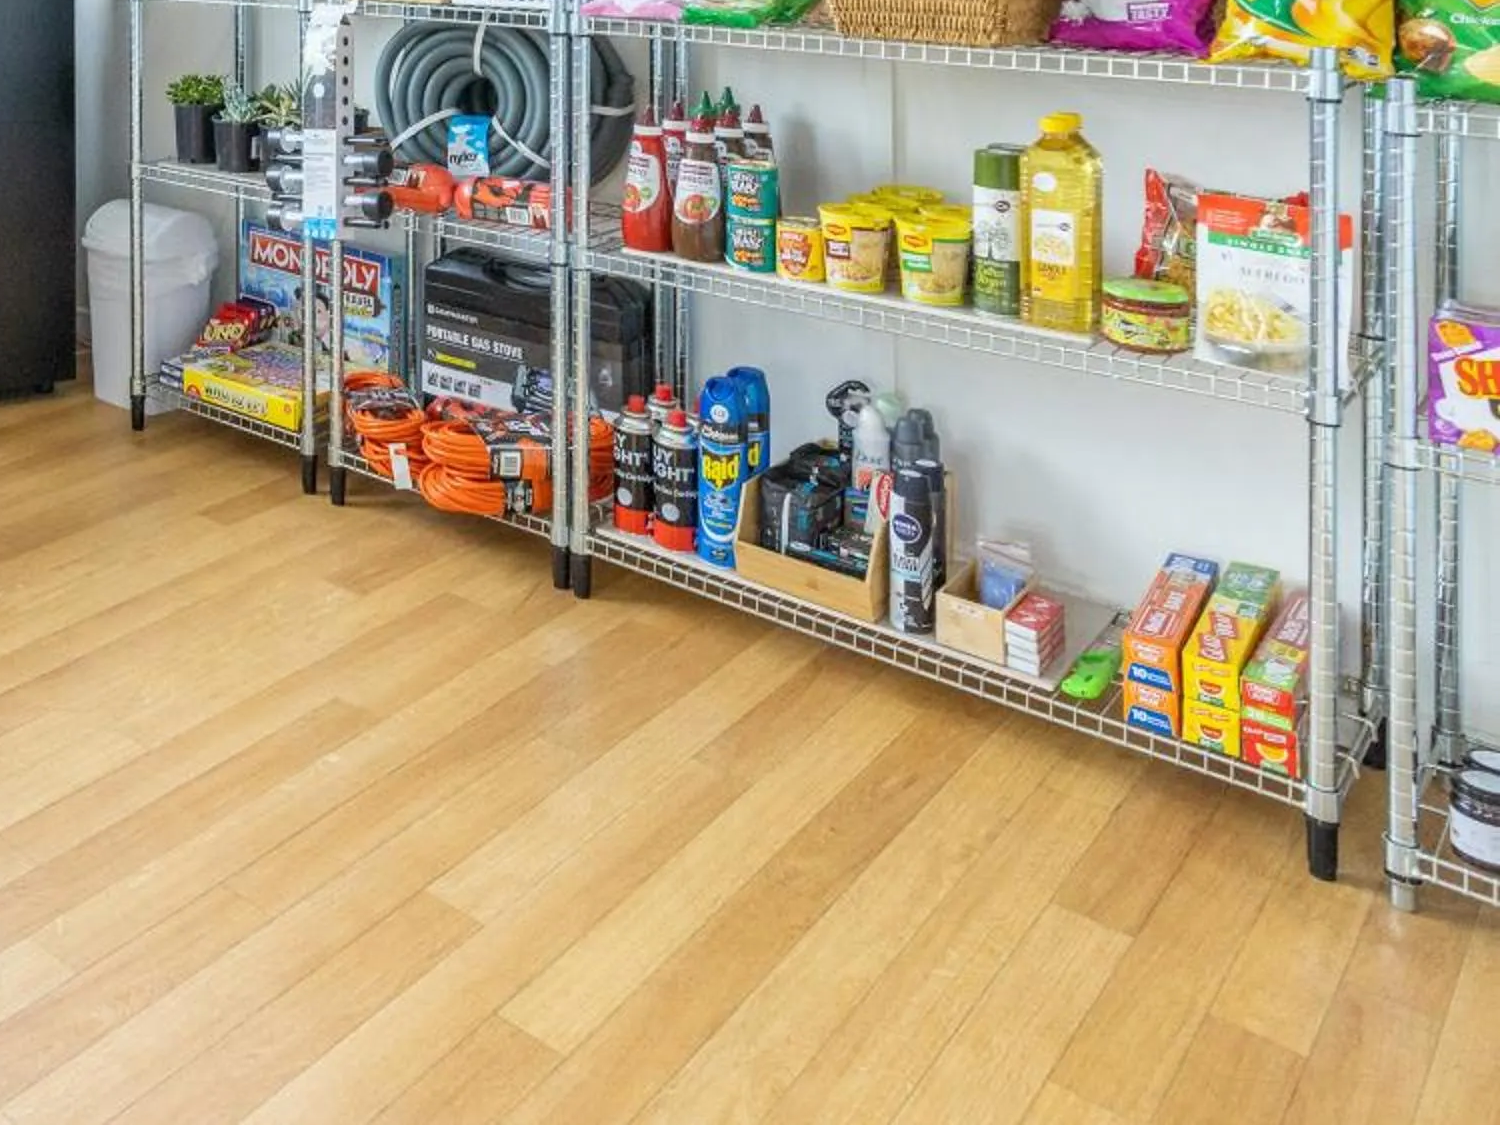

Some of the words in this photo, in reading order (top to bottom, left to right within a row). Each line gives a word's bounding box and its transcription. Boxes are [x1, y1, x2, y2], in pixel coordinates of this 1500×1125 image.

[253, 237, 377, 294] MONPLY
[471, 336, 491, 352] GAS
[493, 340, 523, 360] STOVE
[702, 453, 740, 481] Raid
